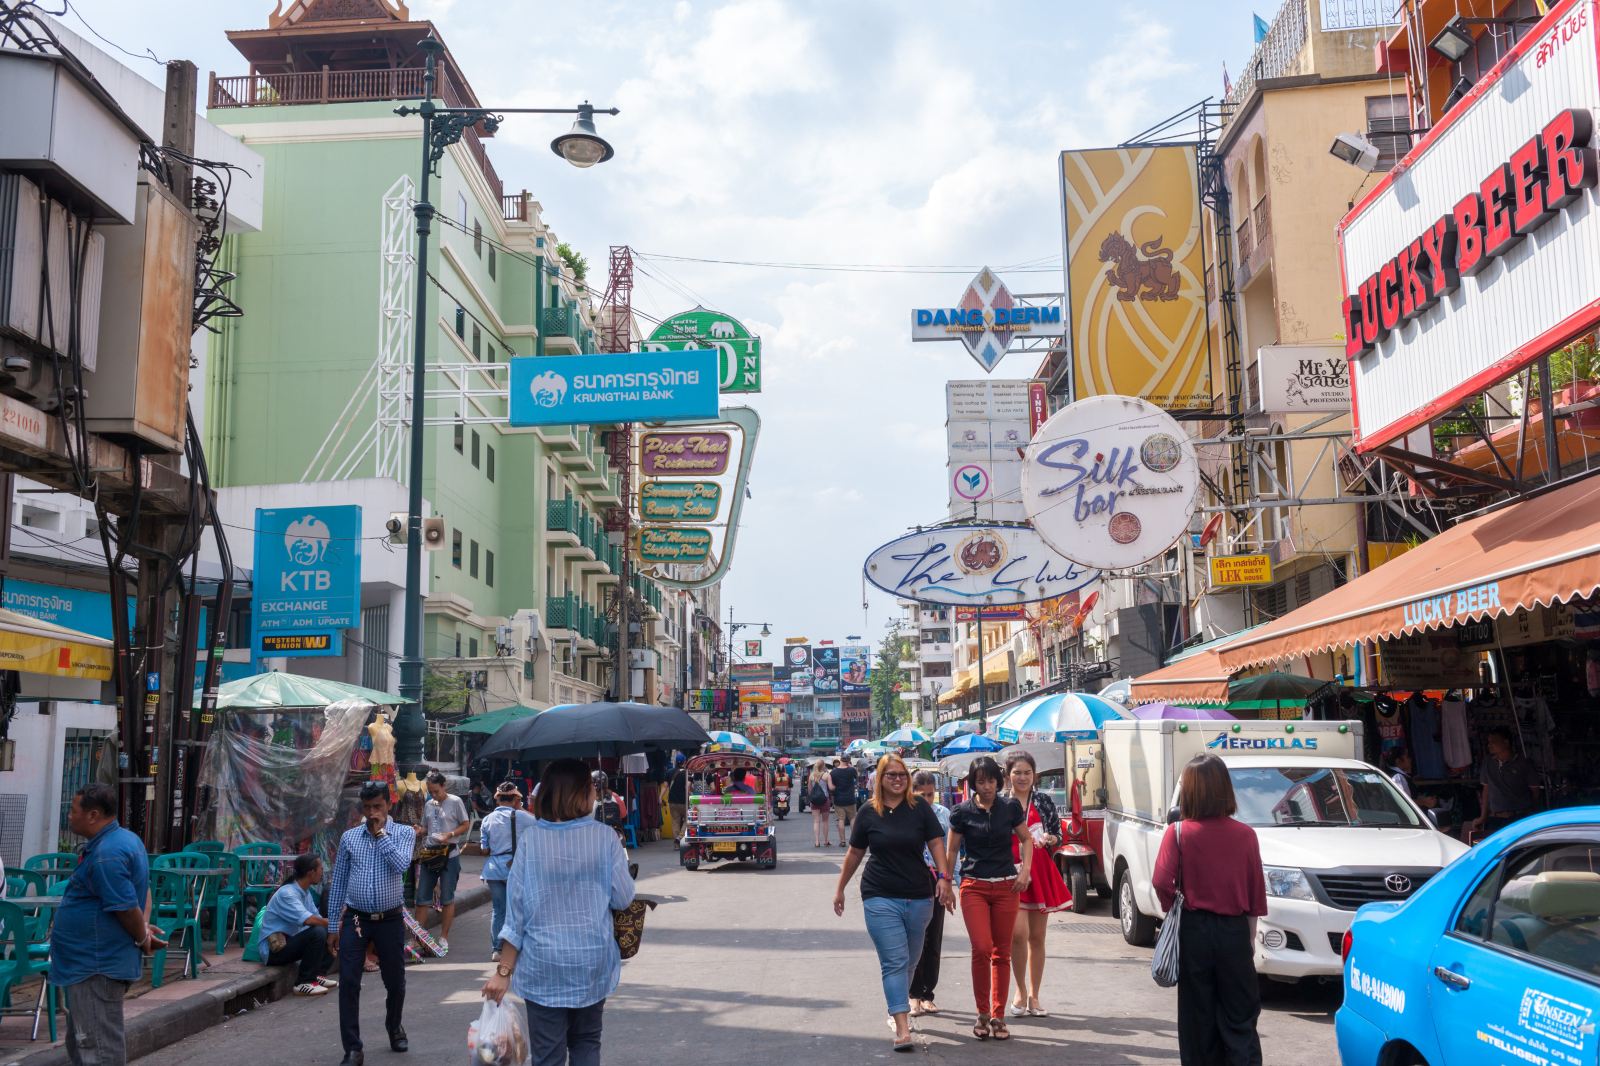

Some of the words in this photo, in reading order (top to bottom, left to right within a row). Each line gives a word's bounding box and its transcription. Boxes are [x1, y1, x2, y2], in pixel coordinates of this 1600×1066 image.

[1344, 215, 1453, 361] LUCKY
[1453, 108, 1592, 277] BEER
[917, 309, 984, 326] DANG
[994, 307, 1060, 325] DERM
[573, 368, 699, 390] ธนาคารกรุงไทย
[573, 391, 640, 404] KRUNGTHAI
[643, 390, 674, 400] BANK
[1034, 393, 1044, 433] INDIA
[1036, 438, 1140, 497] Silk
[1074, 483, 1122, 522] bar
[891, 543, 963, 590] The
[992, 555, 1087, 585] Club
[1218, 569, 1242, 583] LEK
[281, 570, 331, 592] KTB
[261, 600, 328, 613] EXCHANGE
[1403, 592, 1453, 627] LUCKY
[1456, 582, 1501, 615] BEER
[261, 619, 280, 628] ATM
[292, 618, 313, 627] ADM
[318, 617, 350, 626] UPDATE
[1459, 624, 1489, 641] TATTOO
[264, 636, 301, 644] WESTERN
[1206, 732, 1318, 750] AEROKLAS
